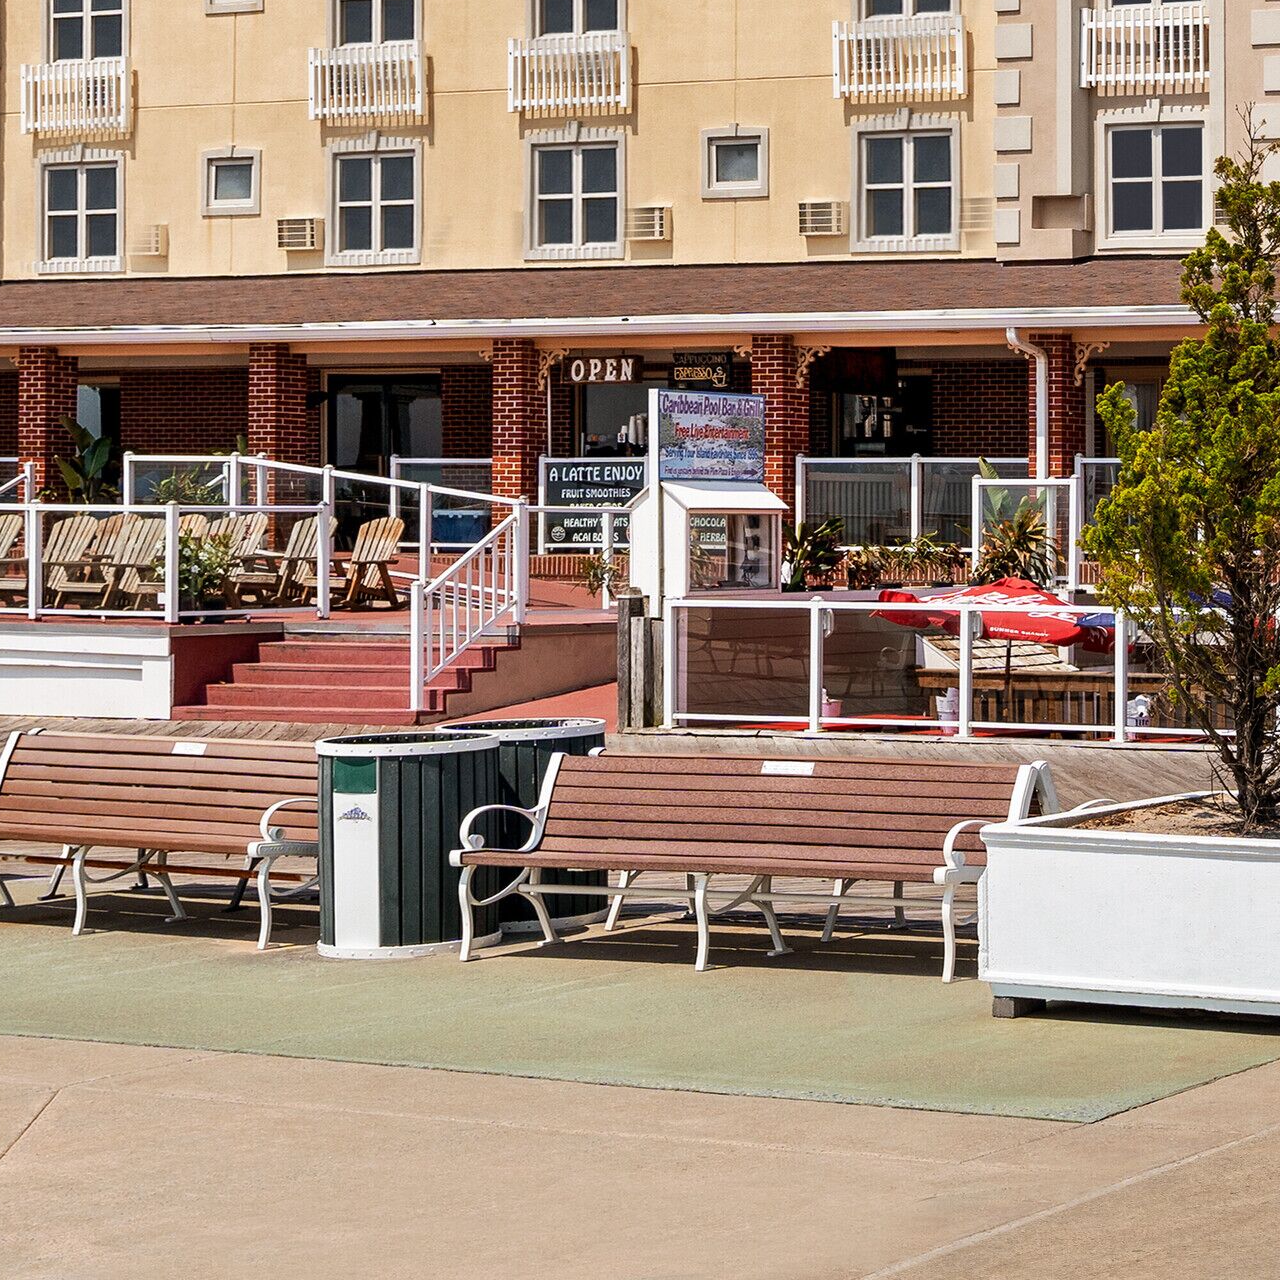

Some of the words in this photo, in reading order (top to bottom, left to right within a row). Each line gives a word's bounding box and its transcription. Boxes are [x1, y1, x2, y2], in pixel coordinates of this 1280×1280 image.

[571, 358, 634, 381] OPEN
[662, 394, 703, 416] Caribbean
[704, 396, 721, 416] Pool
[722, 397, 736, 416] Bar
[744, 399, 760, 417] Grill
[675, 422, 690, 437] Free
[691, 423, 703, 437] Live
[704, 424, 749, 439] Entertainment
[549, 467, 558, 481] A
[562, 467, 600, 481] LATTE
[604, 466, 642, 480] ENJOY
[561, 489, 584, 498] FRUIT
[586, 488, 631, 497] SMOOTHIES
[564, 518, 598, 527] HEALTHY
[600, 518, 629, 527] TATS
[572, 533, 590, 541] ACAI
[592, 532, 619, 541] BOS
